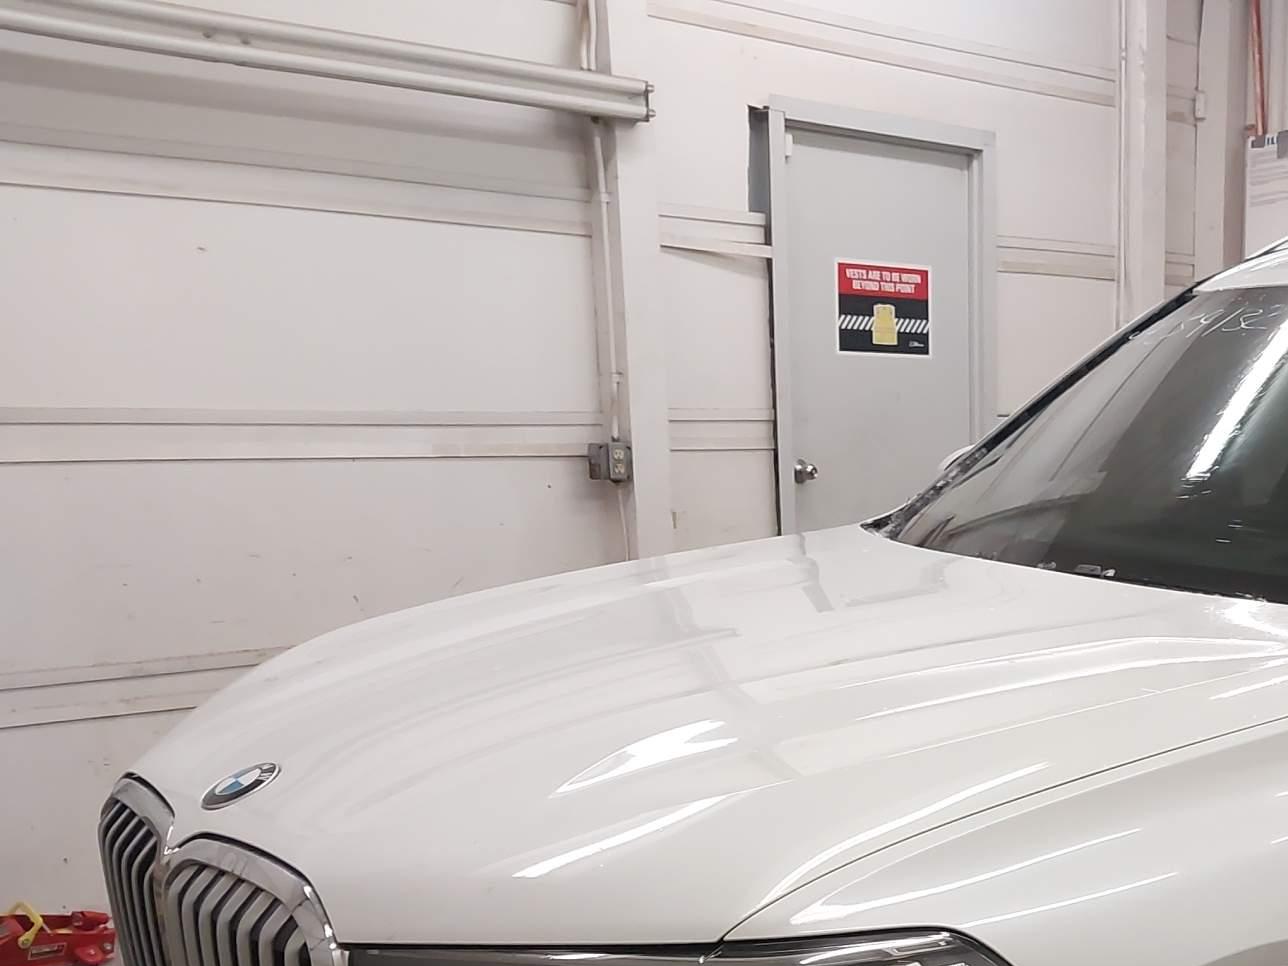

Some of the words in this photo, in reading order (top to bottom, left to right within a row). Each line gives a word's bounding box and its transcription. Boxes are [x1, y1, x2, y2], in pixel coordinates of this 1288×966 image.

[845, 268, 867, 279] VESTS
[868, 270, 881, 281] ARE
[881, 271, 890, 281] TO
[891, 272, 900, 282] BE
[880, 282, 895, 292] THIS
[895, 283, 915, 294] POINT
